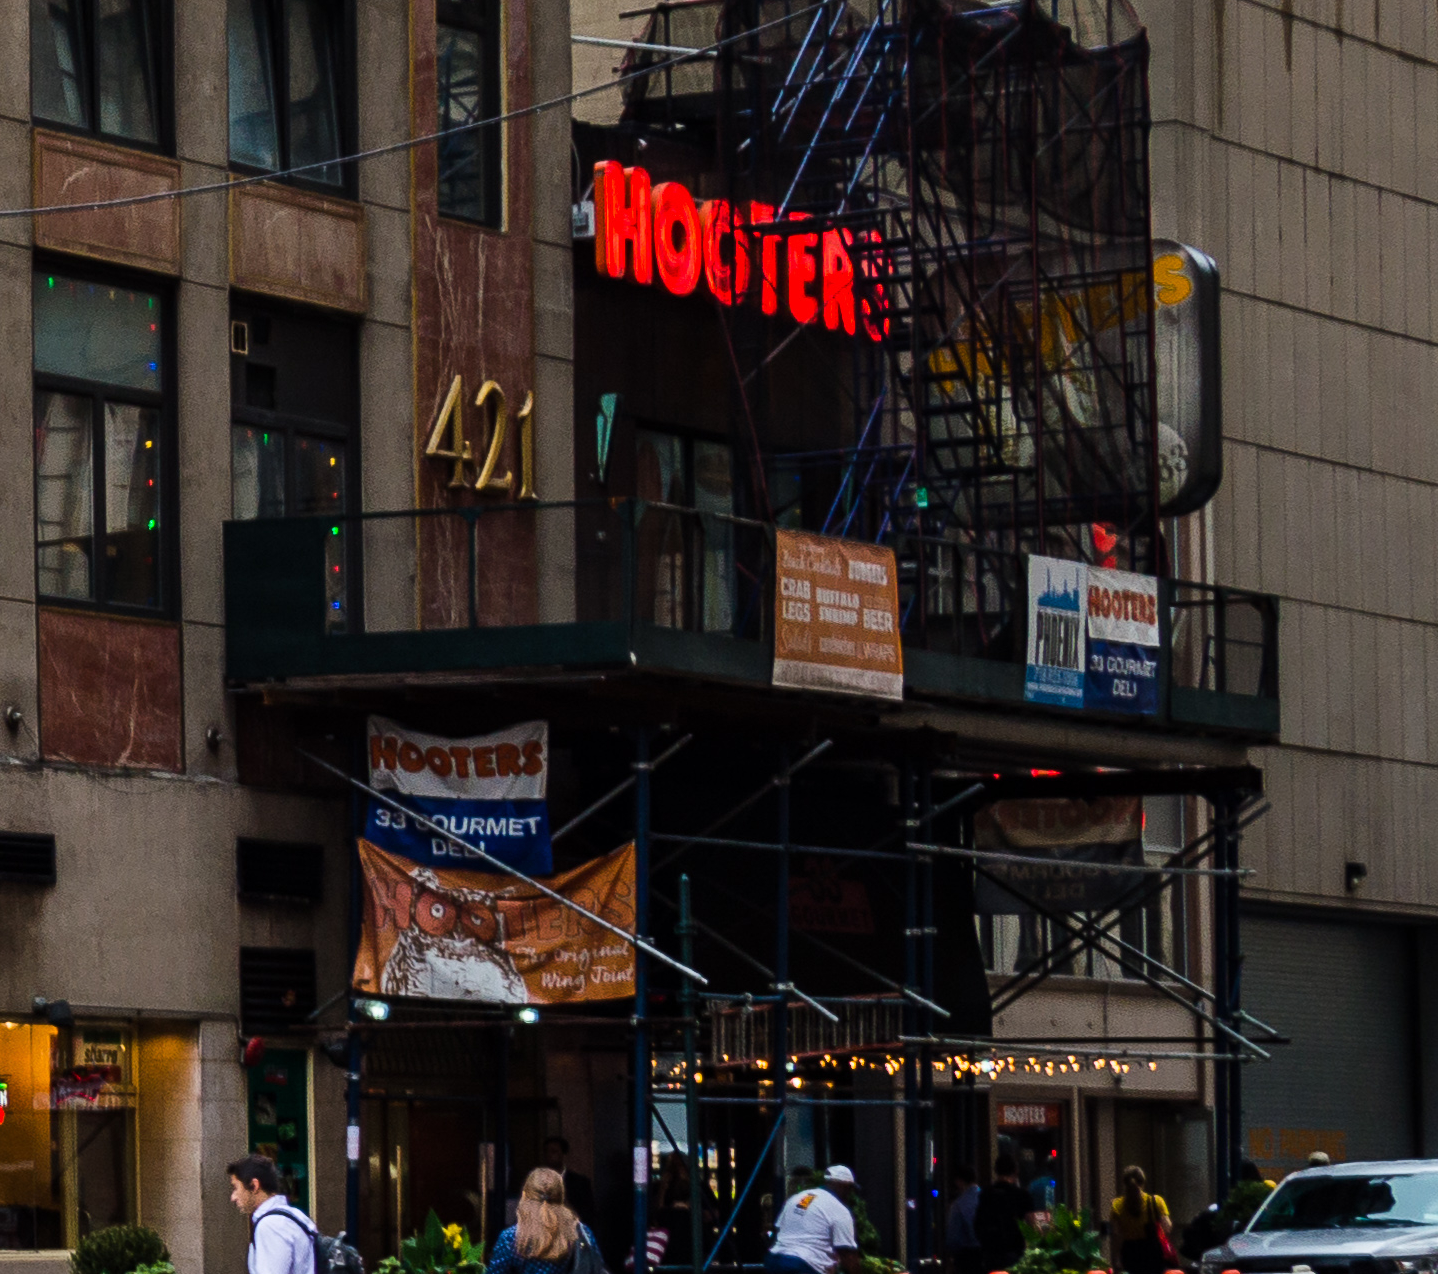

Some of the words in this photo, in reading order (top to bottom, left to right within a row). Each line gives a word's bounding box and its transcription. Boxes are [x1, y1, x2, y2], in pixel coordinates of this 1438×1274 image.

[426, 374, 538, 502] 421
[780, 576, 812, 600] CRAB
[782, 600, 812, 623] LEGS
[1087, 585, 1157, 626] HOOTERS
[1106, 656, 1157, 679] GOURMET
[1112, 678, 1138, 697] DELI
[369, 734, 544, 779] HOOTERS
[375, 808, 406, 830] 33
[553, 941, 630, 971] Original
[541, 971, 586, 994] Wing
[590, 964, 636, 985] Joint
